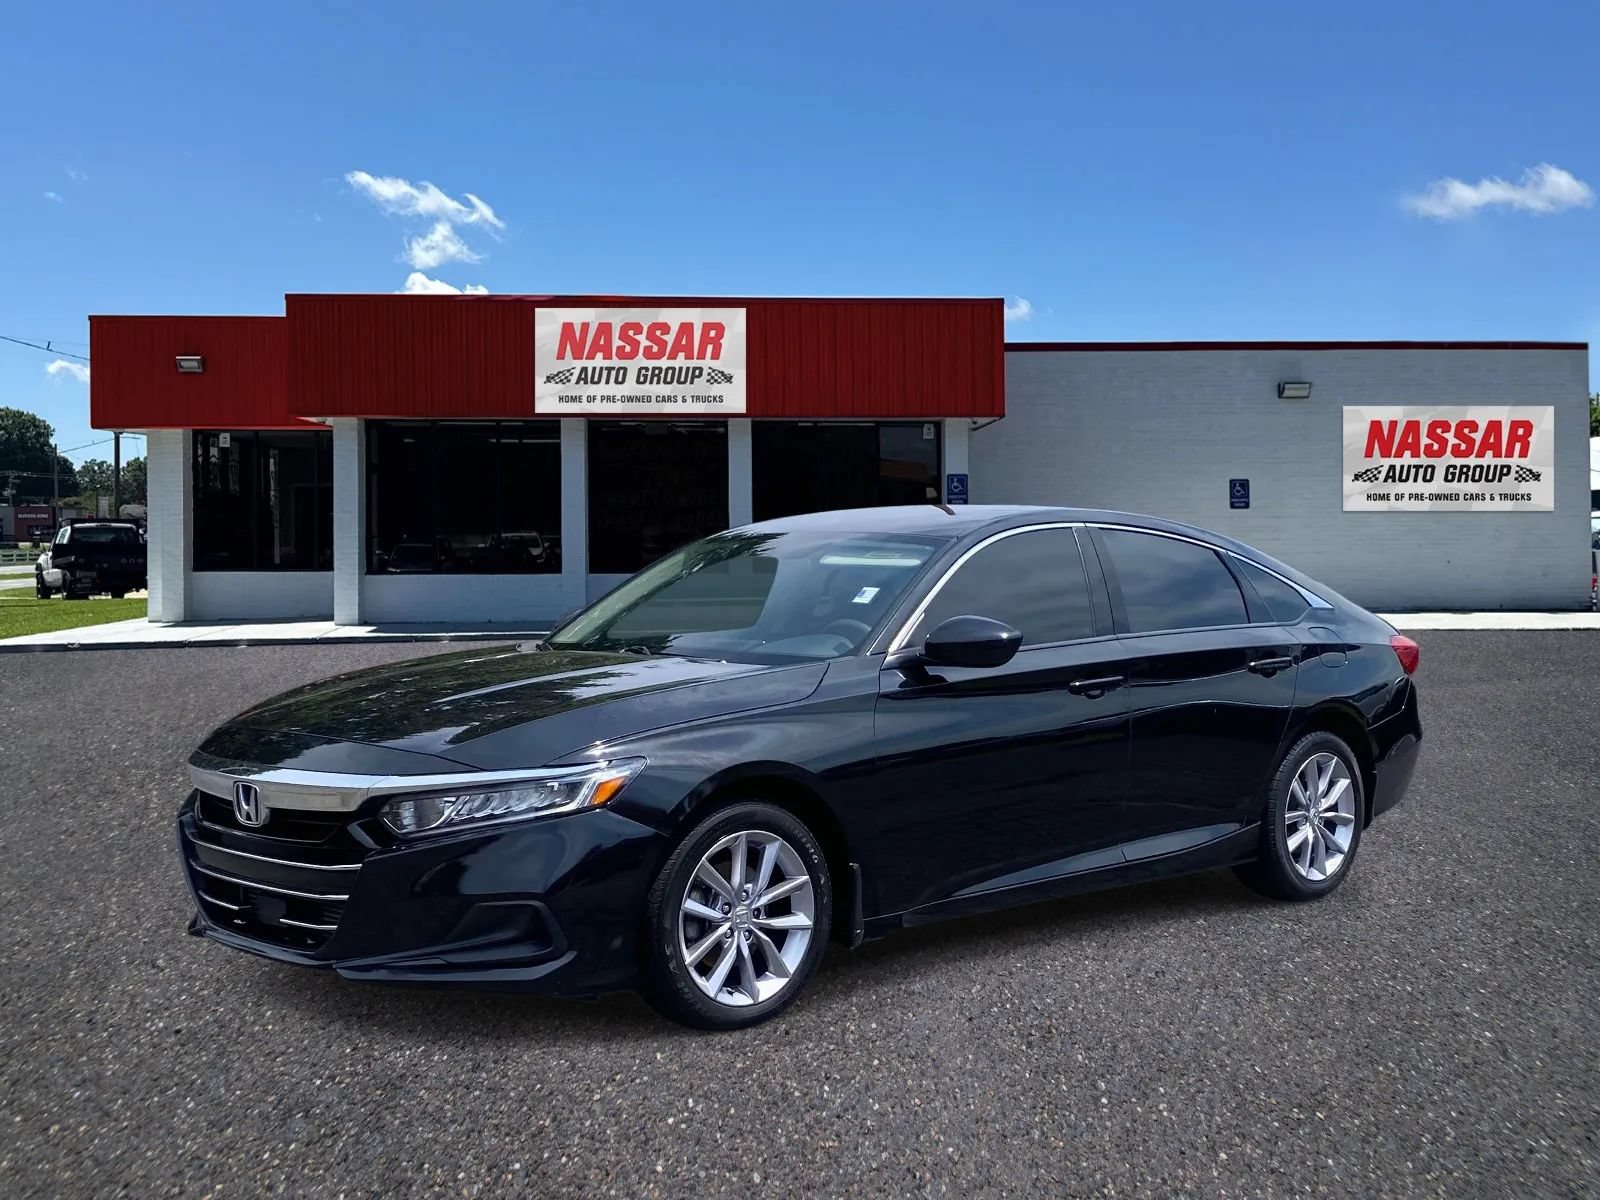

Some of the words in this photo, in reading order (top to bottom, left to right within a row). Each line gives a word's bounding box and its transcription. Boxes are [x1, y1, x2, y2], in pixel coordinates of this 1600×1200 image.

[556, 322, 725, 360] NASSAR
[575, 366, 628, 385] AUTO
[635, 366, 704, 385] GROUP
[558, 395, 583, 404] HOME
[586, 395, 597, 404] OF
[600, 395, 652, 404] PRE-OWNED
[655, 395, 678, 404] CARS
[682, 395, 687, 404] &
[690, 395, 724, 404] TRUCKS
[1364, 420, 1533, 458] NASSAR
[1383, 464, 1436, 483] AUTO
[1443, 464, 1512, 483] GROUP
[1366, 493, 1391, 502] HOME
[1394, 493, 1405, 502] OF
[1408, 493, 1460, 502] PRE-OWNED
[1463, 493, 1486, 502] CARS
[1490, 493, 1495, 502] &
[1498, 493, 1532, 502] TRUCKS
